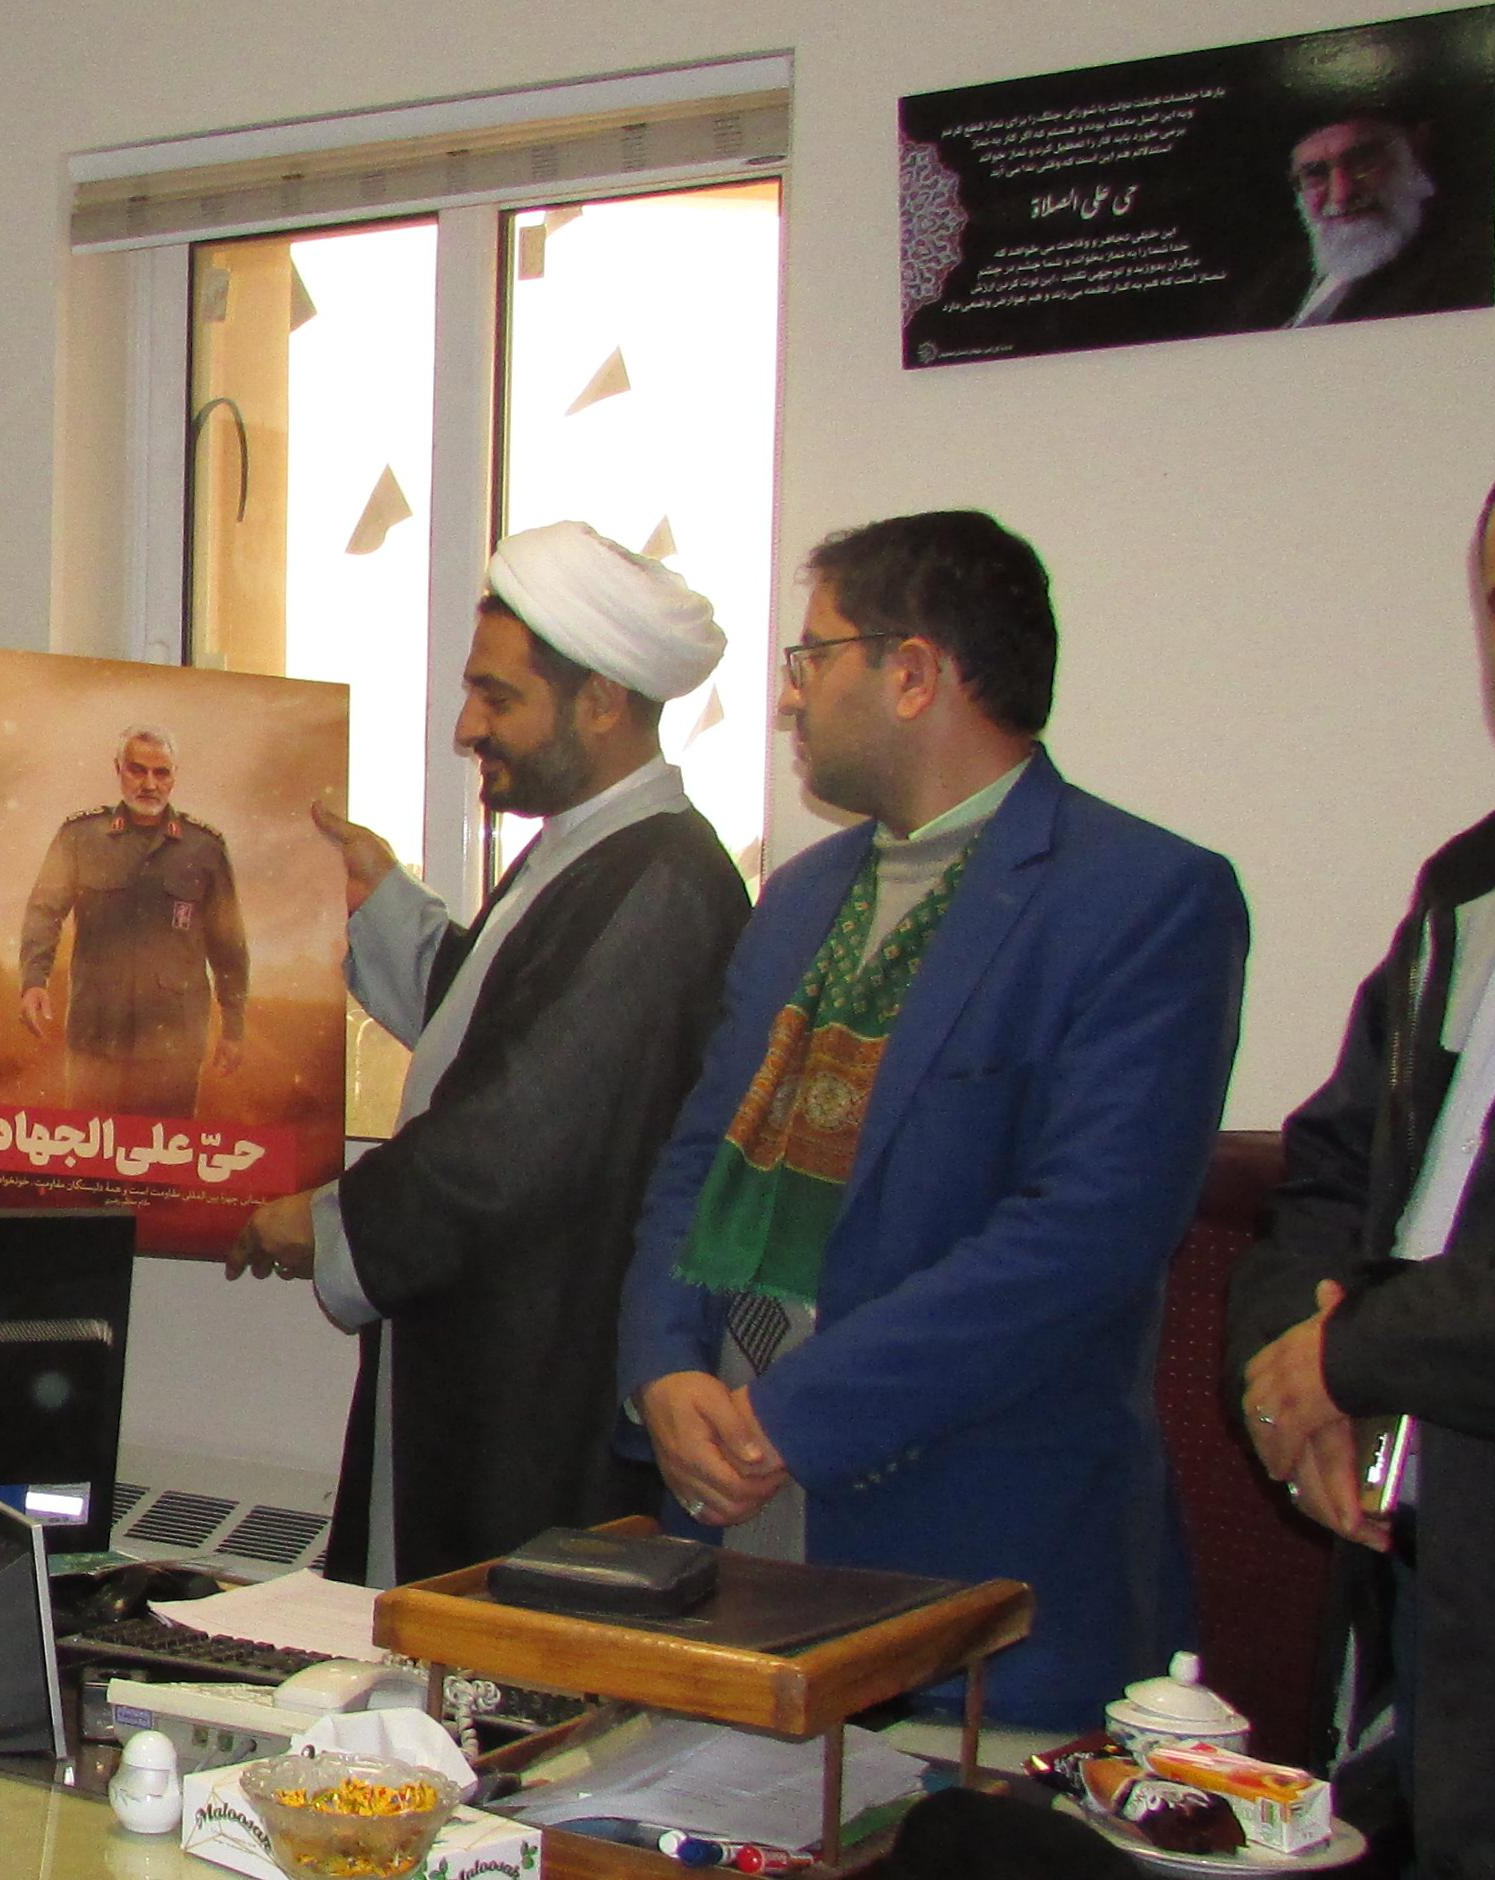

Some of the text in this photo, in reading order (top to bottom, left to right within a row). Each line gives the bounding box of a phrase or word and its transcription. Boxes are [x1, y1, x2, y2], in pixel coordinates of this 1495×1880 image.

[1080, 185, 1110, 220] علی
[1112, 185, 1138, 216] حی
[115, 1123, 194, 1176] علی
[129, 1185, 149, 1196] است
[151, 1185, 181, 1199] مقاومت
